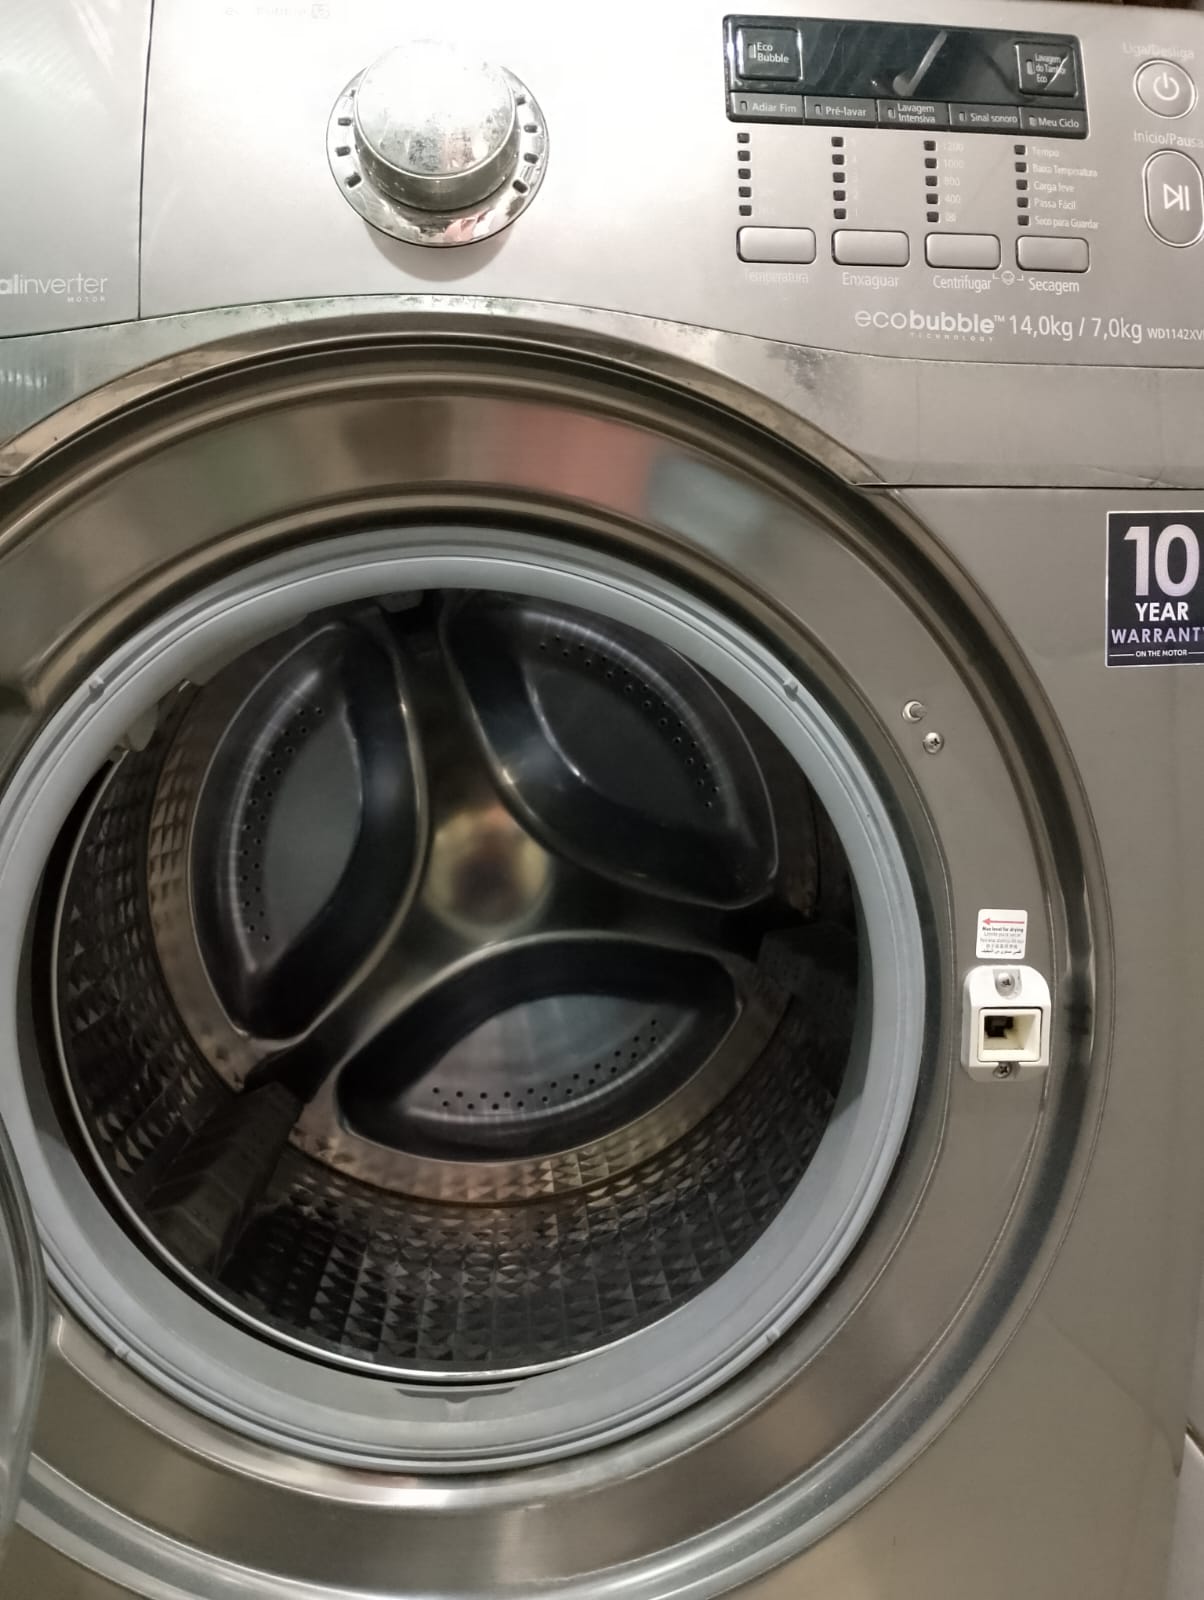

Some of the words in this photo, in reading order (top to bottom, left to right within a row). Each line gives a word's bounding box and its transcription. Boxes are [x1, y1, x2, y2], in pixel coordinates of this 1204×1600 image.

[757, 41, 773, 51] Eco
[757, 52, 789, 64] Bubble
[1037, 73, 1048, 83] Eco
[752, 102, 776, 112] Adiar
[780, 103, 797, 113] Fim
[825, 106, 867, 117] Pré-lavar
[898, 103, 935, 115] Lavagem
[898, 113, 936, 124] Intensiva
[970, 112, 990, 122] Sinal
[991, 114, 1018, 124] sonoro
[1038, 116, 1057, 127] Meu
[1059, 117, 1080, 128] Ciclo
[1034, 181, 1057, 193] Carga
[842, 272, 900, 290] Enxaguar
[932, 274, 992, 293] Centrifugar
[1028, 277, 1080, 295] Secagem
[1010, 315, 1073, 342] 14,0kg
[1091, 317, 1143, 344] 7,0kg
[1146, 327, 1204, 341] WD1142XV
[1124, 524, 1200, 597] 10
[1135, 602, 1189, 622] YEAR
[1135, 650, 1147, 658] ON
[1162, 649, 1188, 657] MOTOR
